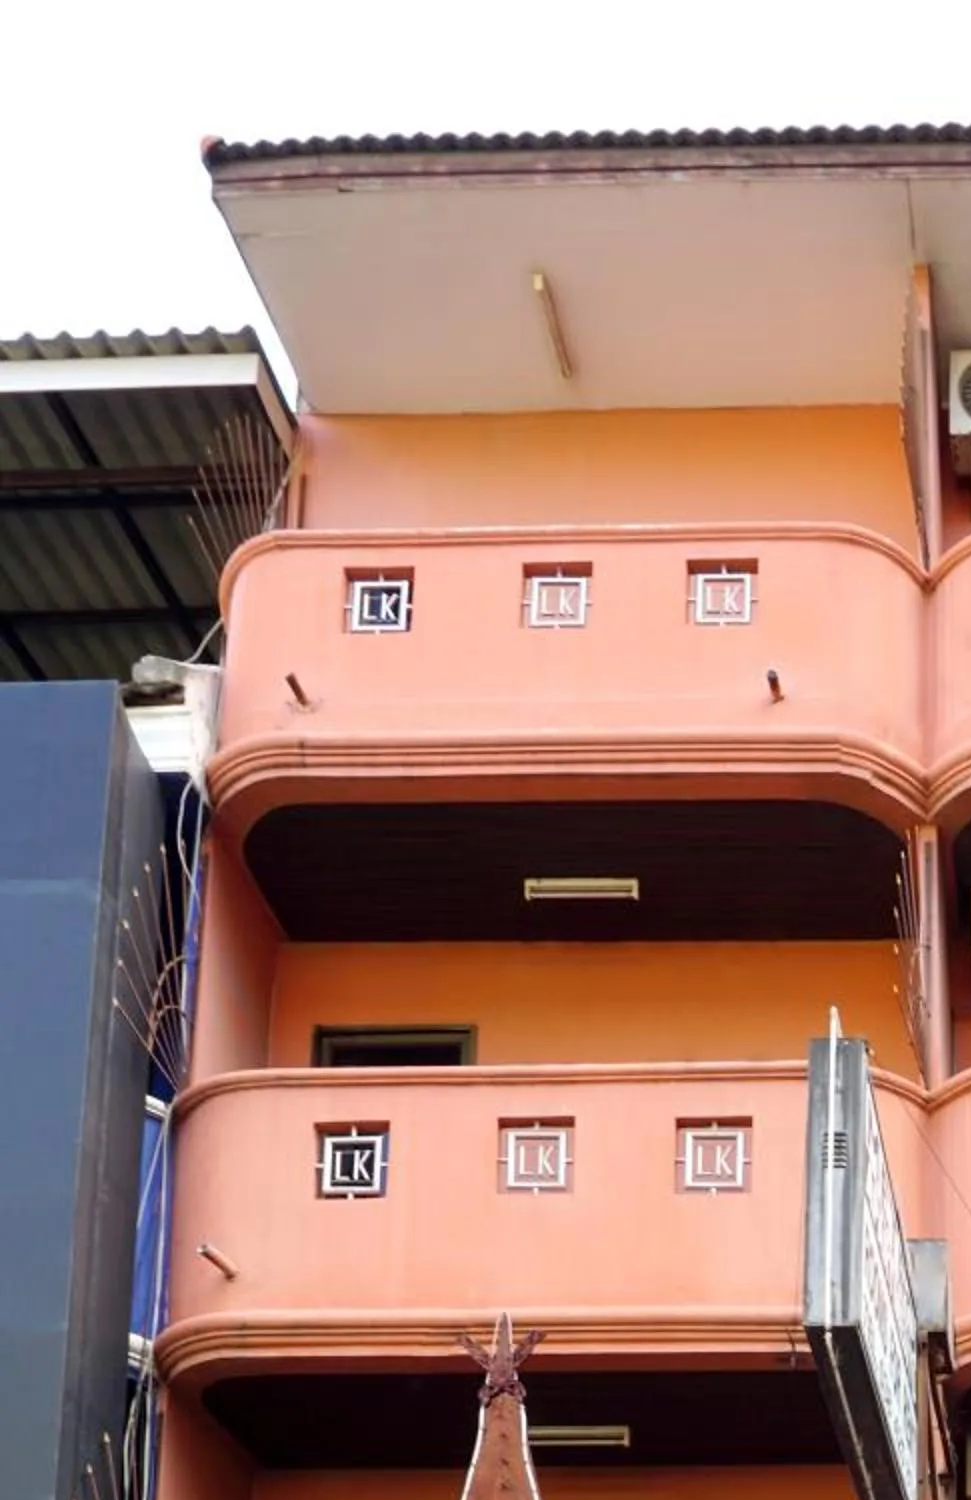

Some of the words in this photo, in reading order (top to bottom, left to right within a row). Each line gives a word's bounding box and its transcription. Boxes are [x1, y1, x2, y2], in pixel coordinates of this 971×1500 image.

[363, 592, 399, 620] LK
[541, 588, 576, 615] LK
[706, 585, 741, 613] LK
[334, 1149, 372, 1180] LK
[519, 1144, 556, 1175] LK
[697, 1144, 733, 1175] LK
